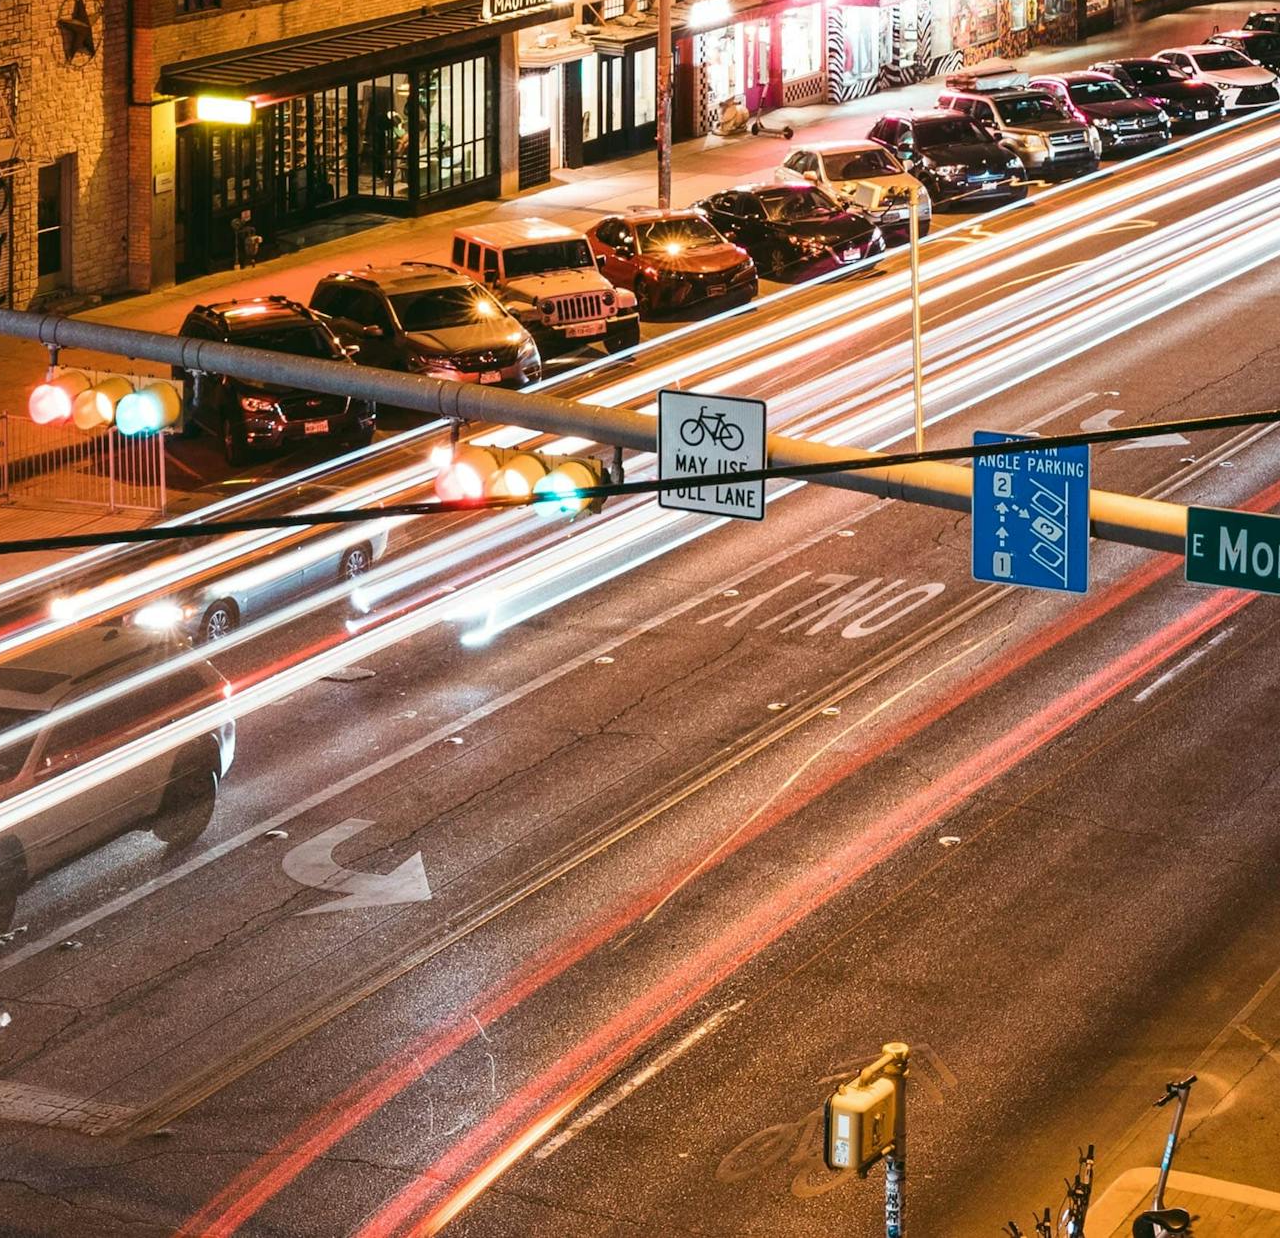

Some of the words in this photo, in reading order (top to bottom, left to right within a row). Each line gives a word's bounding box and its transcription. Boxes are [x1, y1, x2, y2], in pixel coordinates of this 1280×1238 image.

[676, 454, 707, 474] MAY
[978, 454, 1021, 470] ANGLE
[1027, 458, 1084, 478] PARKING
[715, 485, 756, 508] LANE
[1192, 533, 1205, 557] E
[696, 570, 946, 639] ONLY
